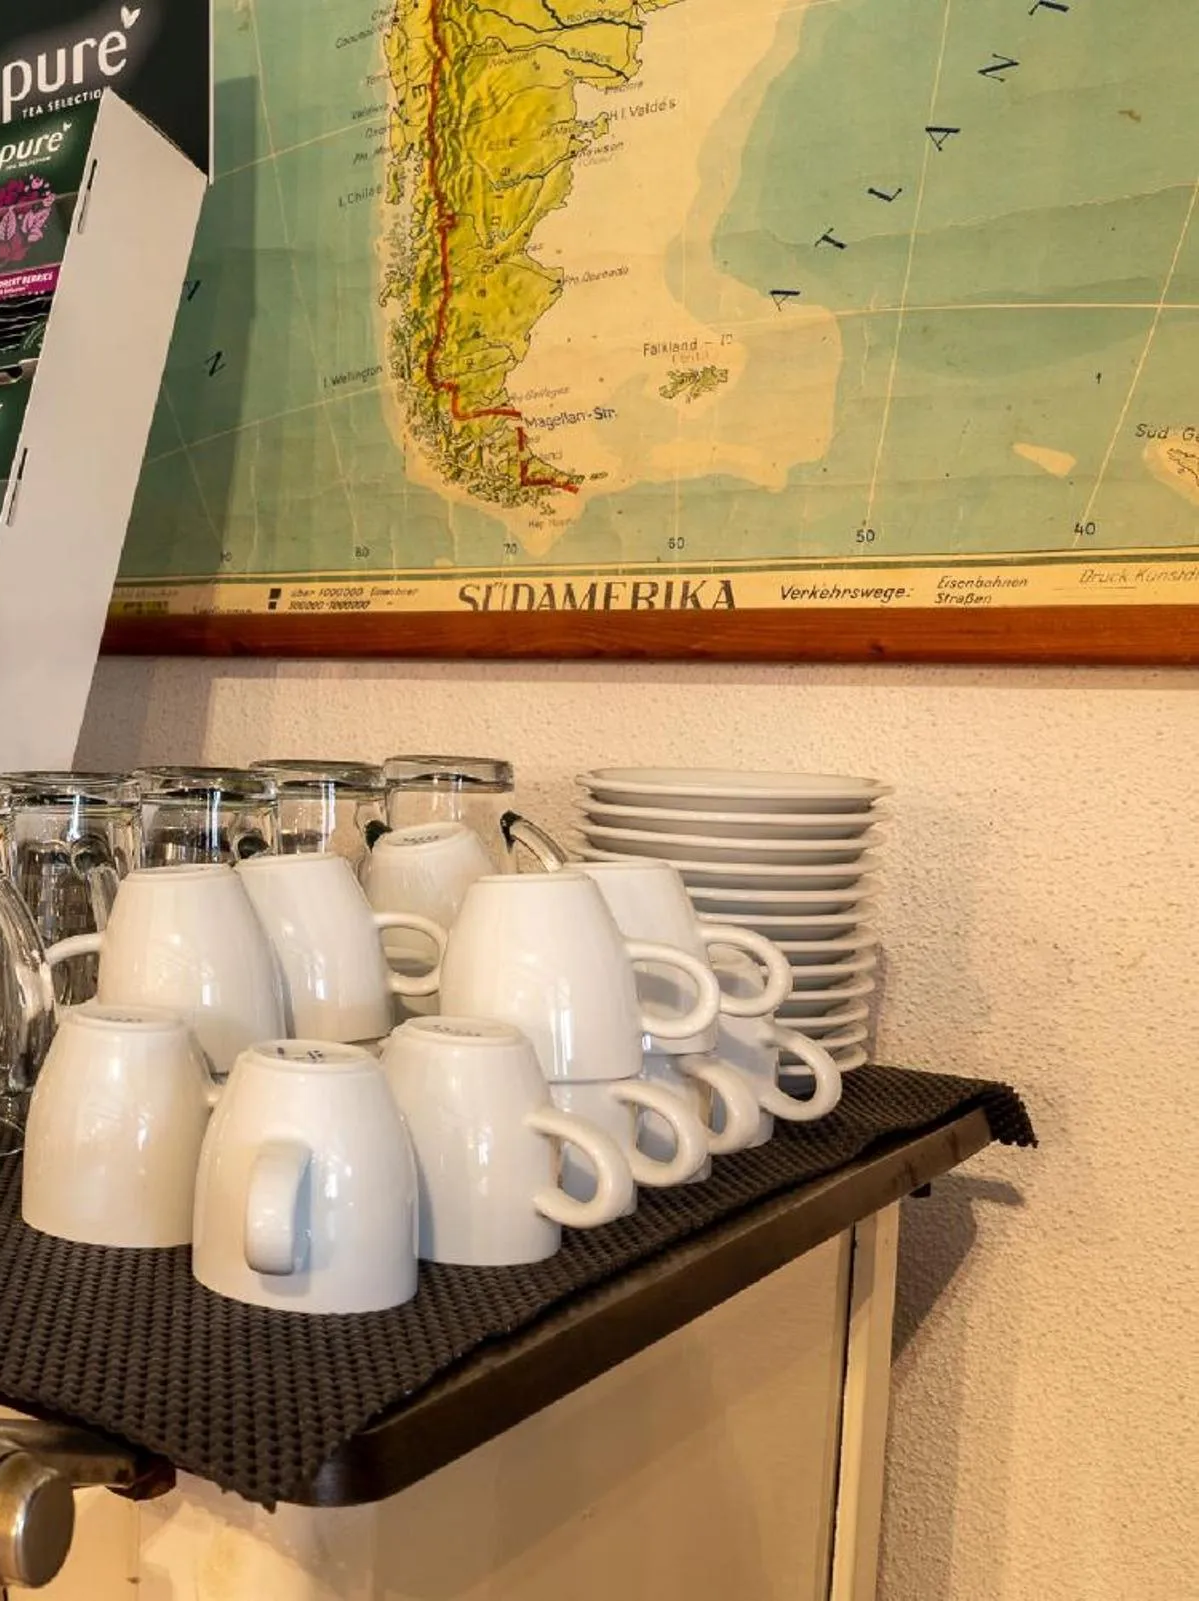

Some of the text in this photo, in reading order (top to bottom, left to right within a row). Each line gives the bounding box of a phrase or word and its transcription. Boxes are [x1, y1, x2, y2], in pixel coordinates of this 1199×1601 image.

[3, 31, 127, 124] pure
[22, 88, 102, 118] TEA SELECTIO
[643, 338, 698, 357] Falkland
[856, 528, 875, 543] 50
[1074, 522, 1096, 535] 40
[668, 537, 685, 550] 60
[937, 575, 1029, 590] Eisenbahnen
[934, 592, 992, 605] Straßen
